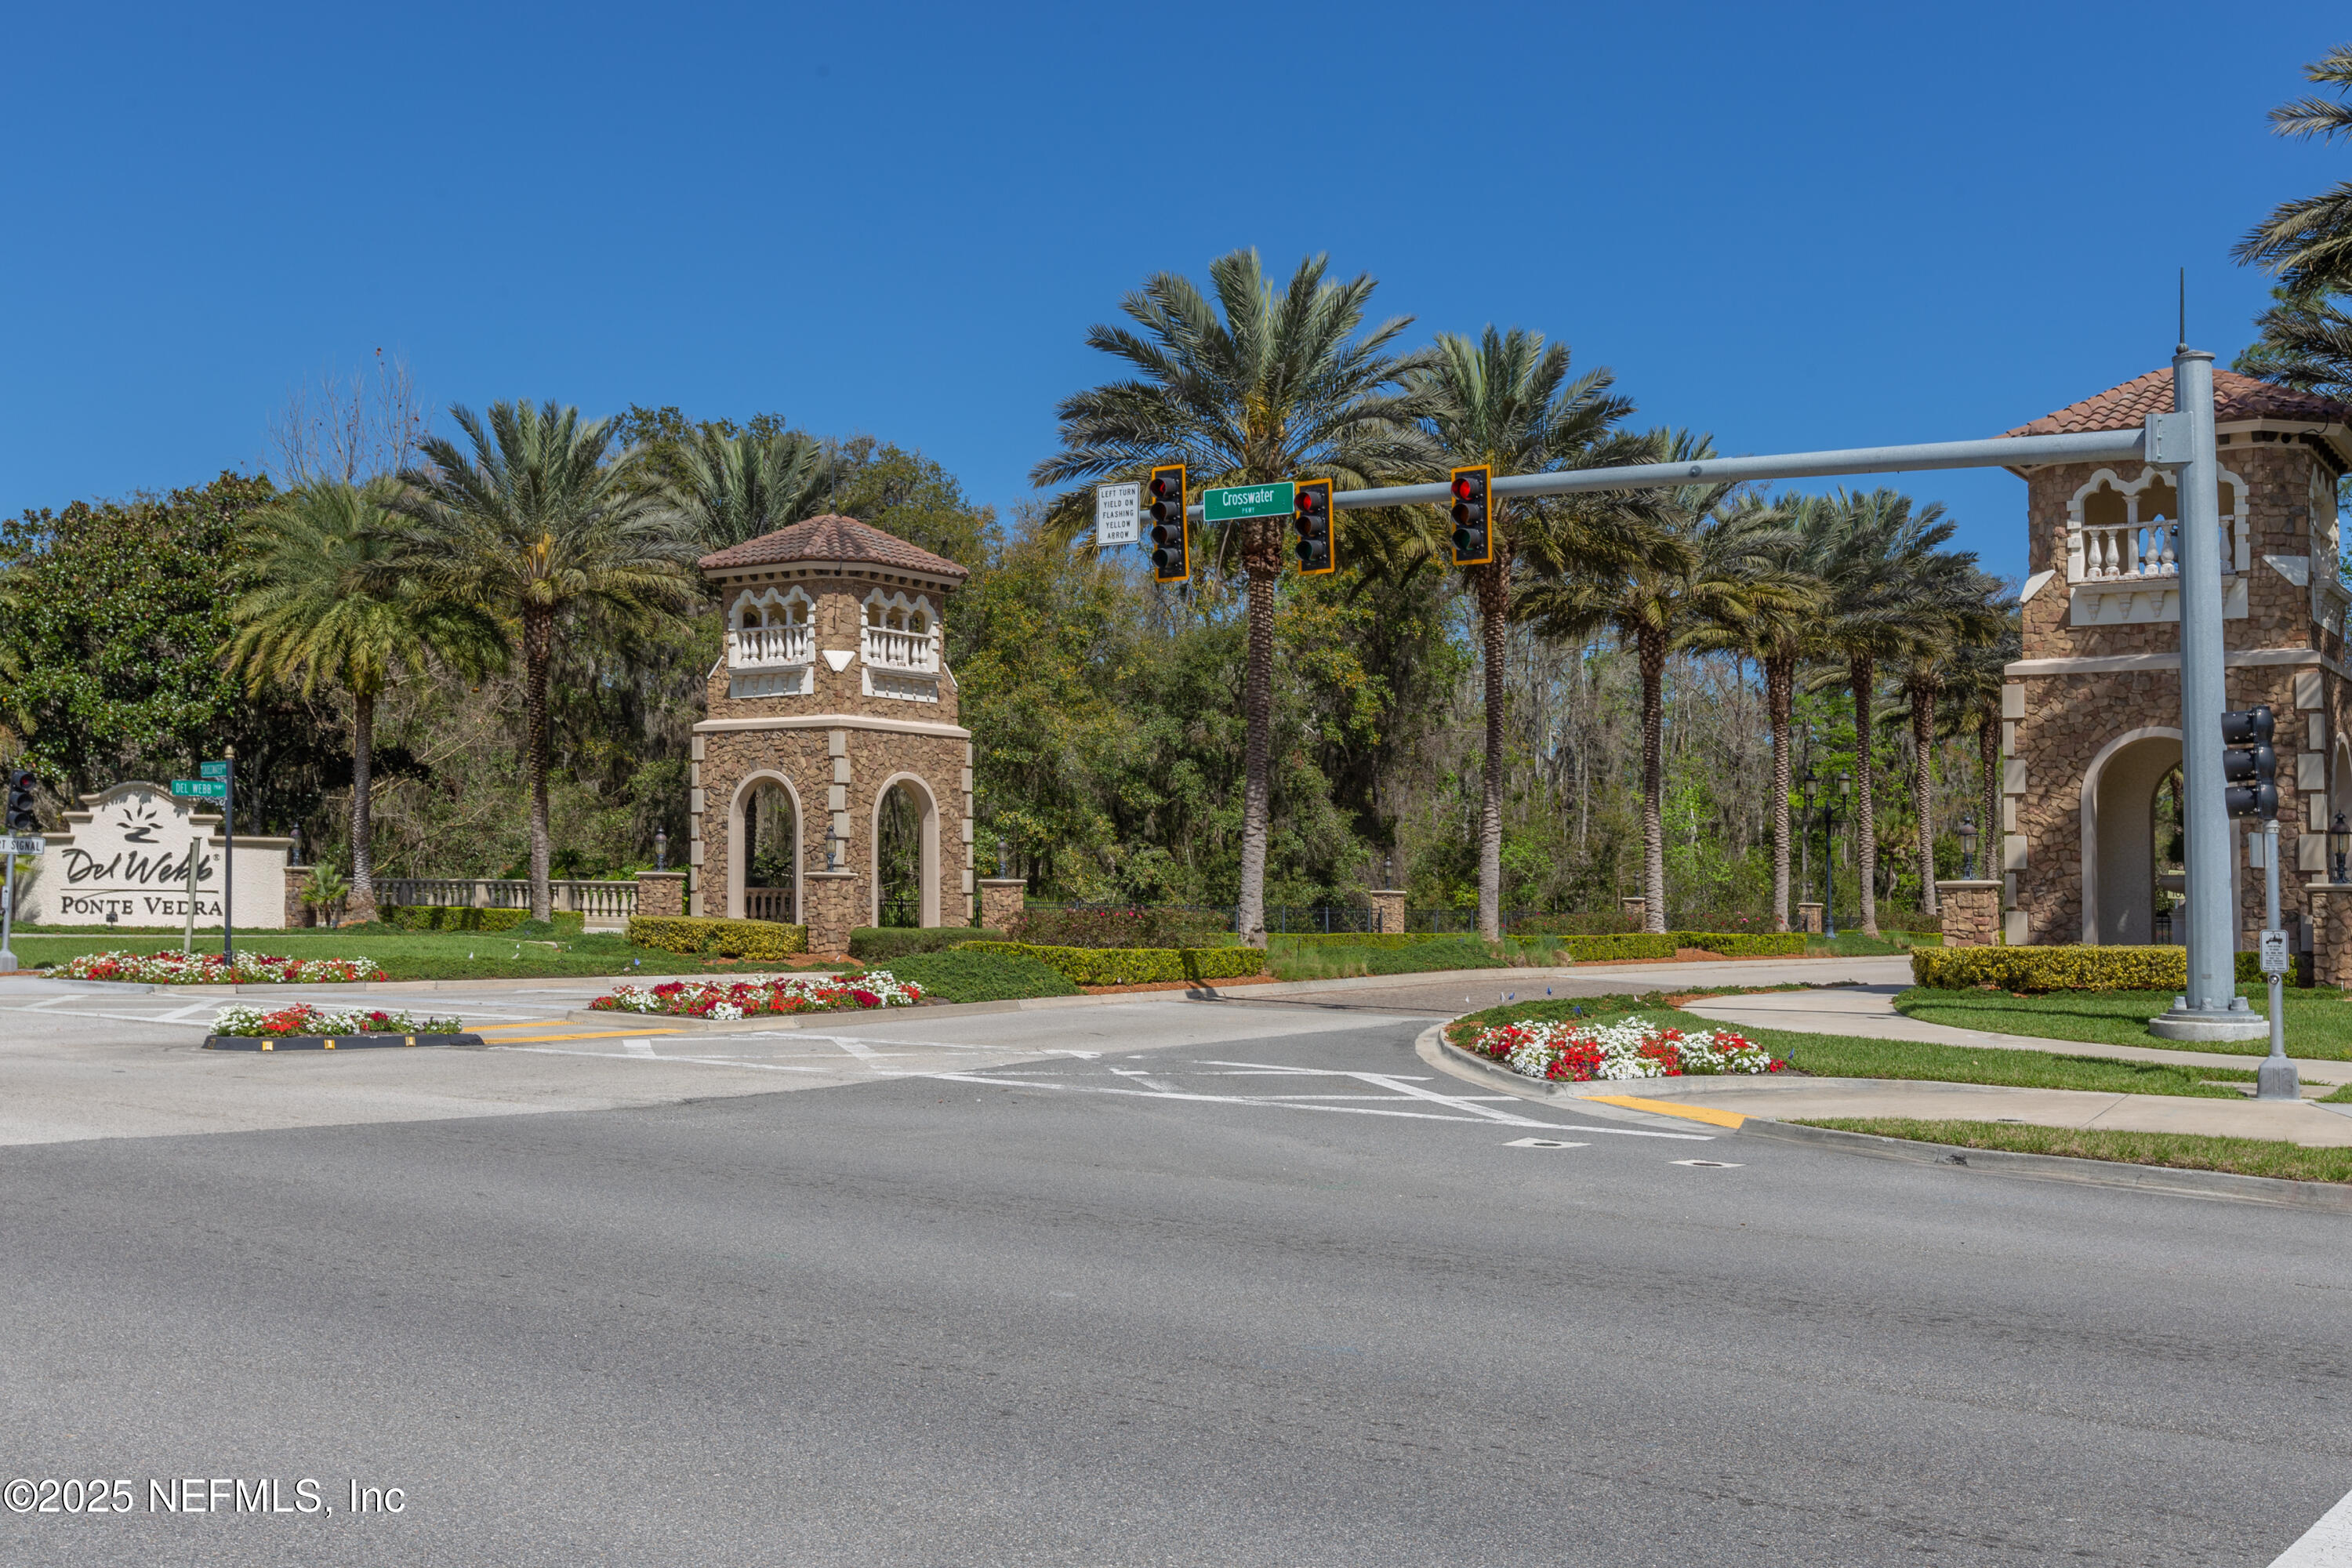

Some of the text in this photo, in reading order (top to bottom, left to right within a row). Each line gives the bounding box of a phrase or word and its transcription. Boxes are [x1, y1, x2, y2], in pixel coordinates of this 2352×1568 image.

[1101, 488, 1136, 499] LEFT TURN
[1222, 488, 1274, 506] Crosswater
[1103, 500, 1122, 509] YIELD
[1102, 510, 1134, 519] FLASHING
[1105, 521, 1131, 529] YELLOW
[1107, 531, 1129, 540] ARROW
[176, 782, 189, 793] DEL
[192, 783, 212, 794] WEBB
[11, 840, 41, 851] SIGNAL
[62, 848, 122, 884] Del
